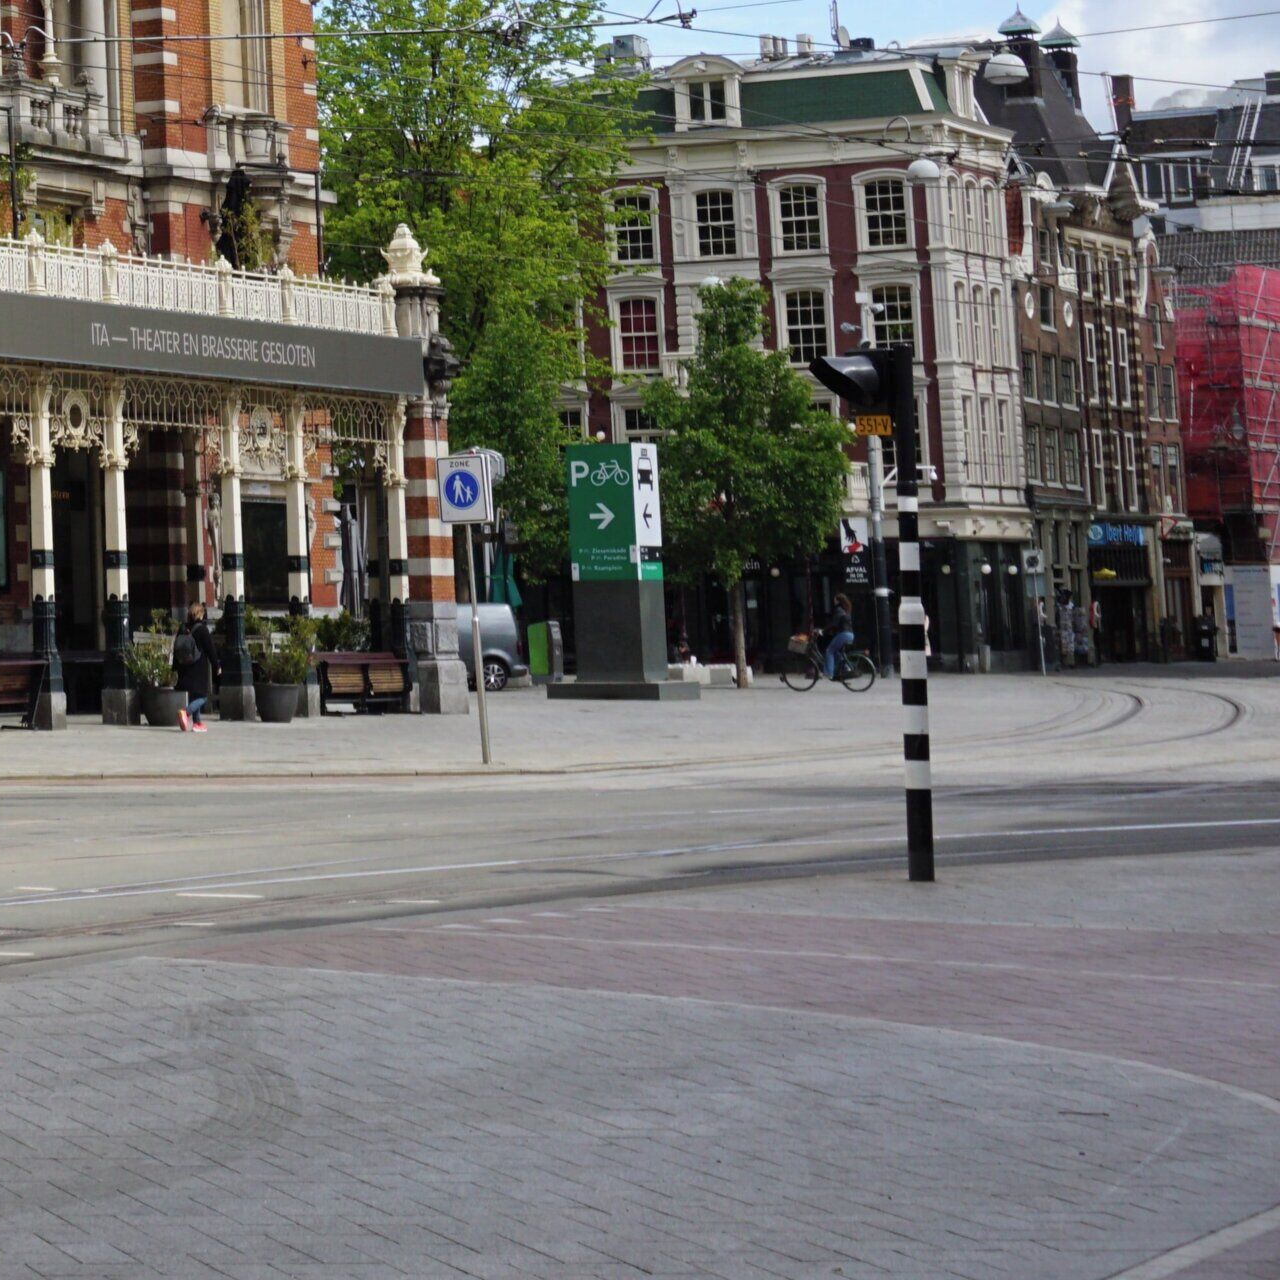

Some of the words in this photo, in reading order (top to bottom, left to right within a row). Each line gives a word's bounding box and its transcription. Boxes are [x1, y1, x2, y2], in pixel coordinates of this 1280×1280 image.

[91, 322, 110, 347] ITA
[130, 326, 181, 355] THEATER
[183, 332, 199, 357] EN
[201, 335, 259, 362] BRASSERIE
[261, 341, 316, 368] GESLOTEN
[858, 416, 890, 433] 551-V
[449, 460, 470, 468] ZONE
[570, 460, 590, 488] P
[846, 566, 867, 574] AFVAL
